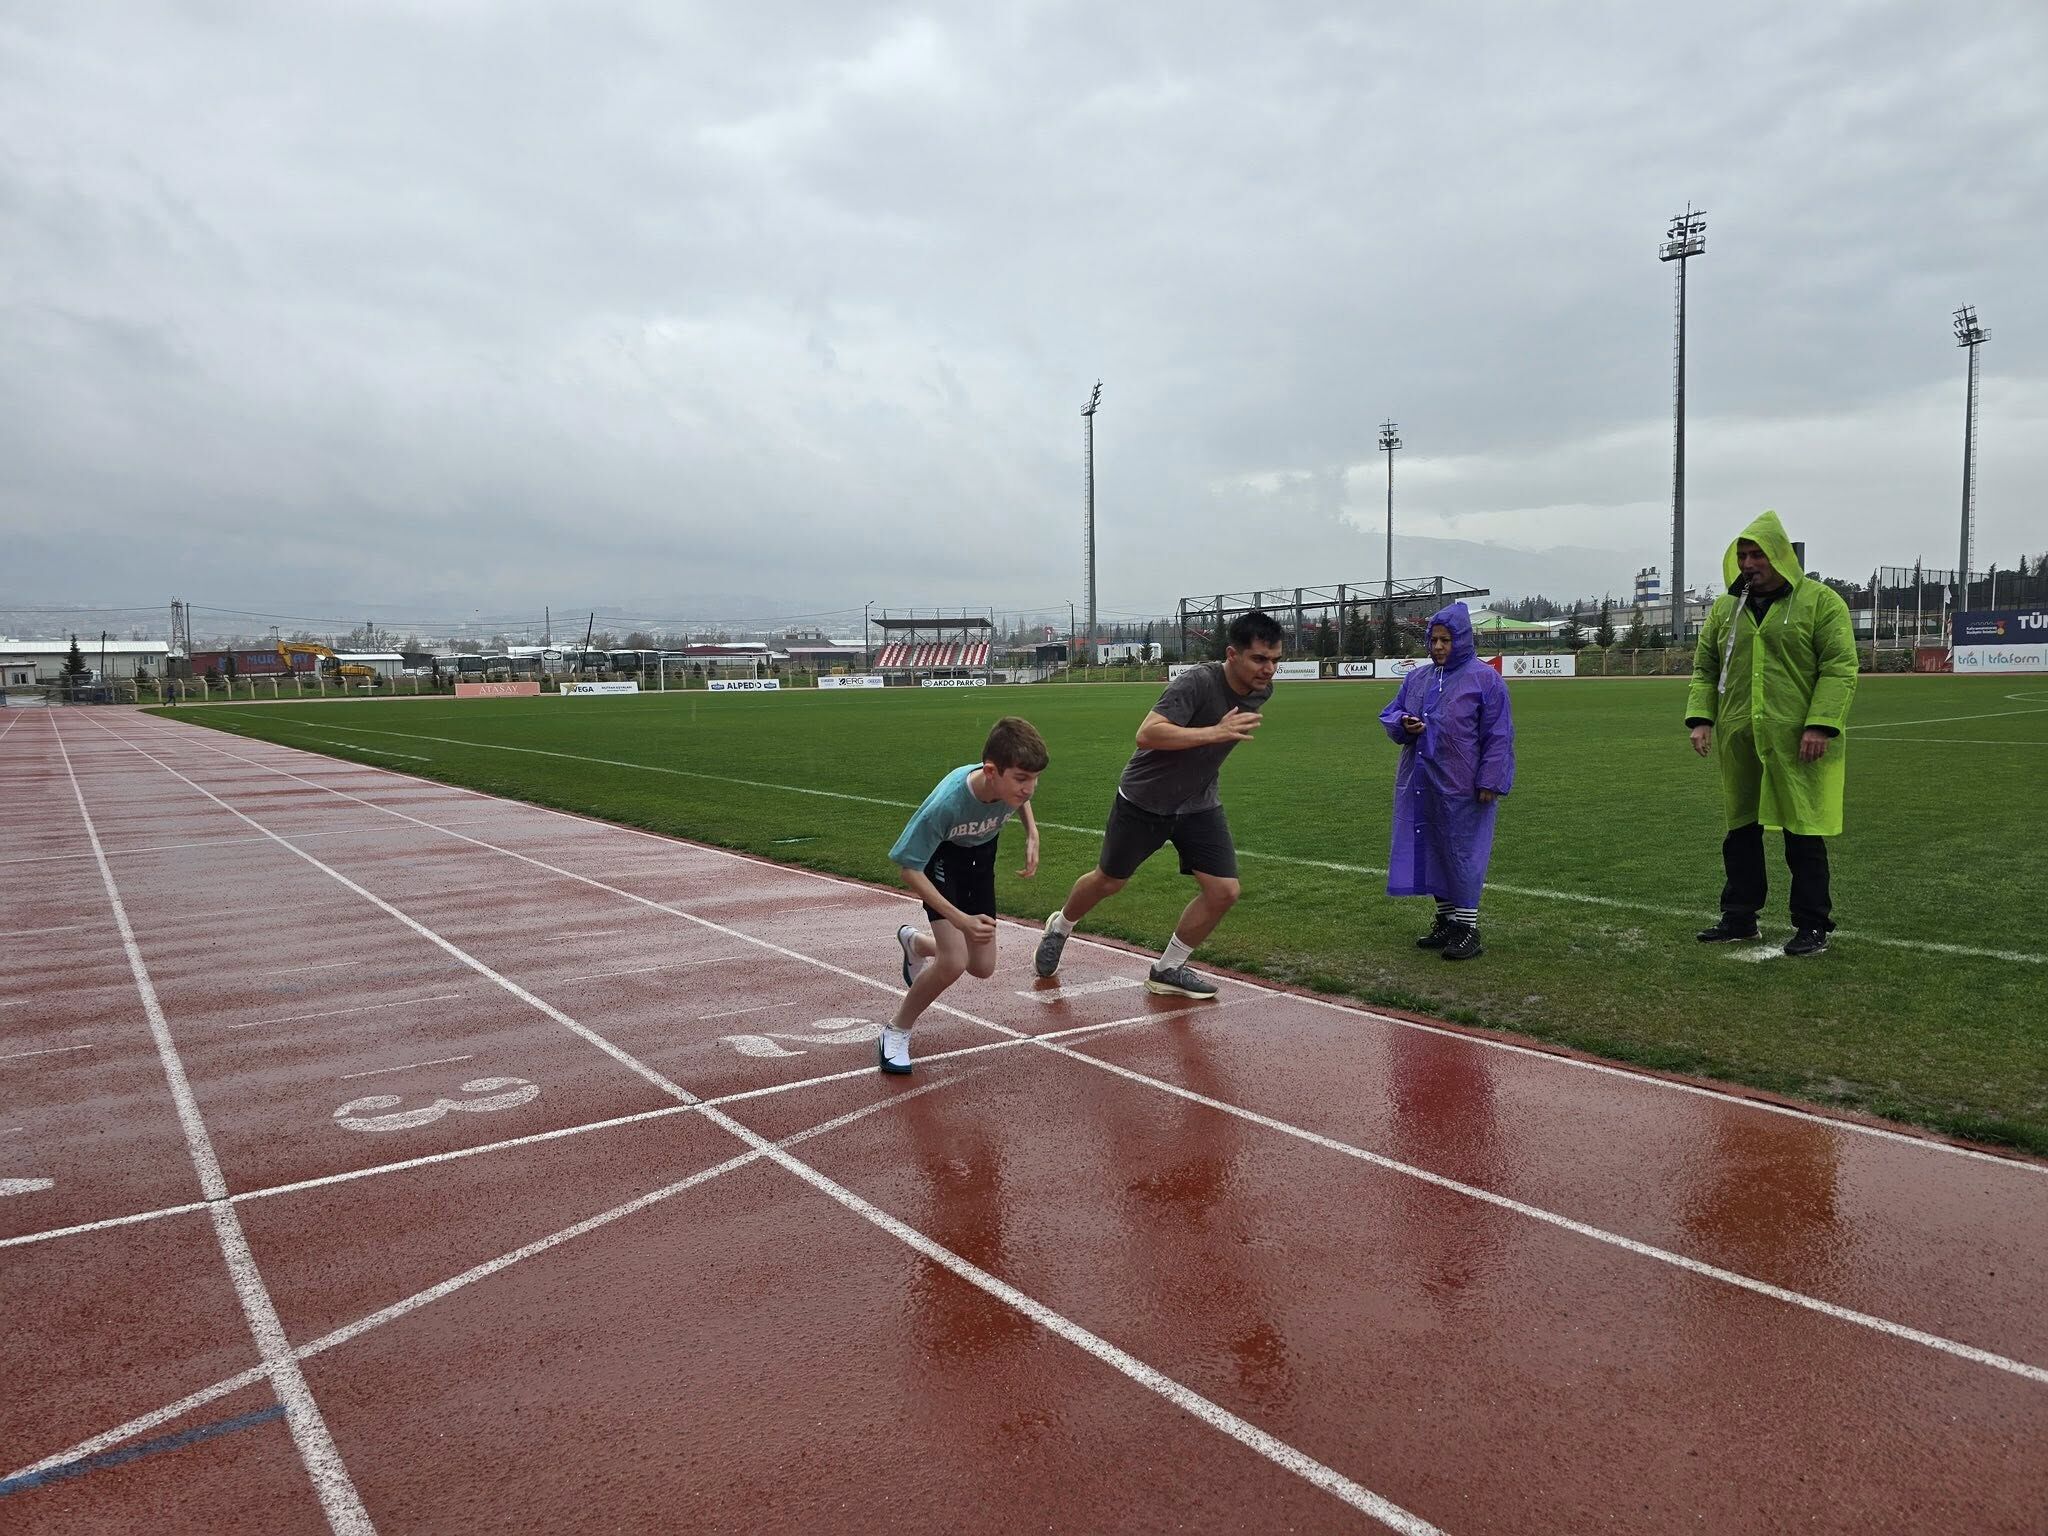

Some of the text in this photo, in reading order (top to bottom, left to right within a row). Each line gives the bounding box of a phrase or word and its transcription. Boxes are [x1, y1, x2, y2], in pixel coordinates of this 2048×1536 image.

[1532, 657, 1560, 668] İLBE
[727, 681, 762, 690] ALPEDO
[933, 679, 955, 687] AKDO
[479, 685, 519, 694] ATASAY
[948, 817, 998, 839] DREAM
